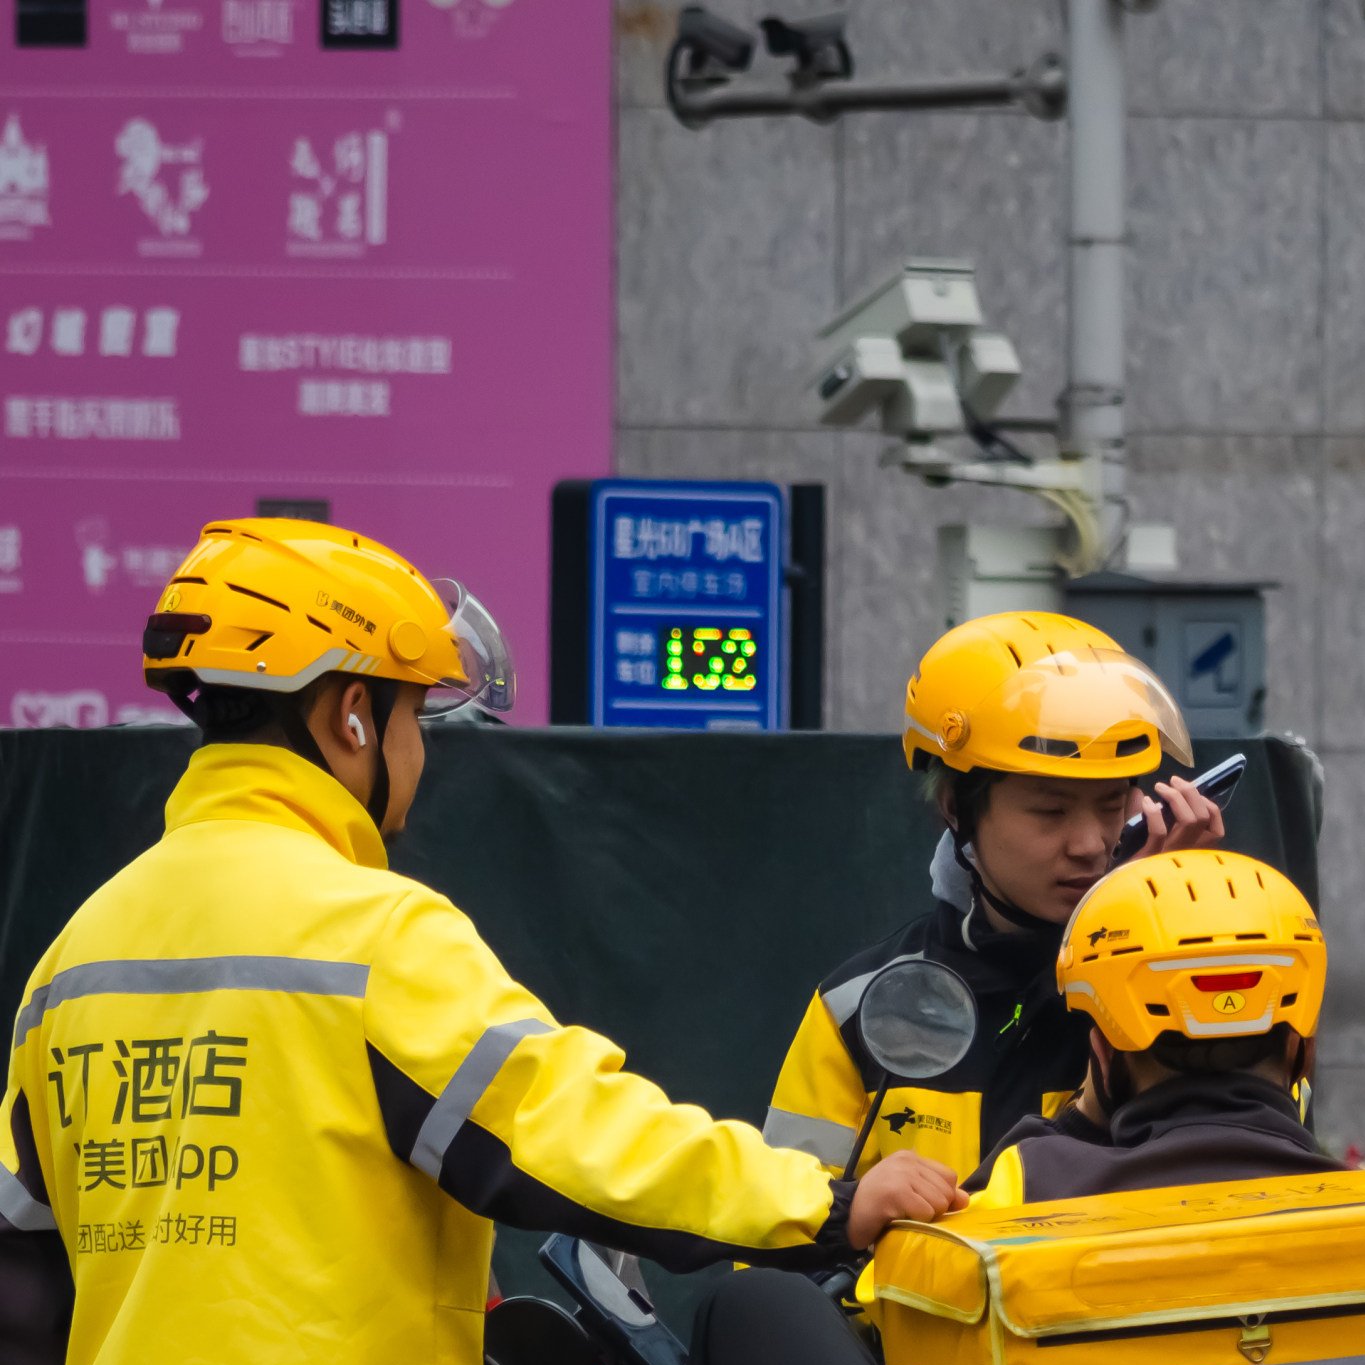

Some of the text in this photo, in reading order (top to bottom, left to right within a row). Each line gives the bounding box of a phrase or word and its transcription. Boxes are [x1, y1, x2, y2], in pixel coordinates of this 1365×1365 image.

[330, 599, 378, 637] 美团外卖
[1222, 995, 1237, 1011] A
[48, 1029, 249, 1129] 订酒店
[73, 1134, 240, 1193] 美团pp
[77, 1219, 147, 1255] 团配送
